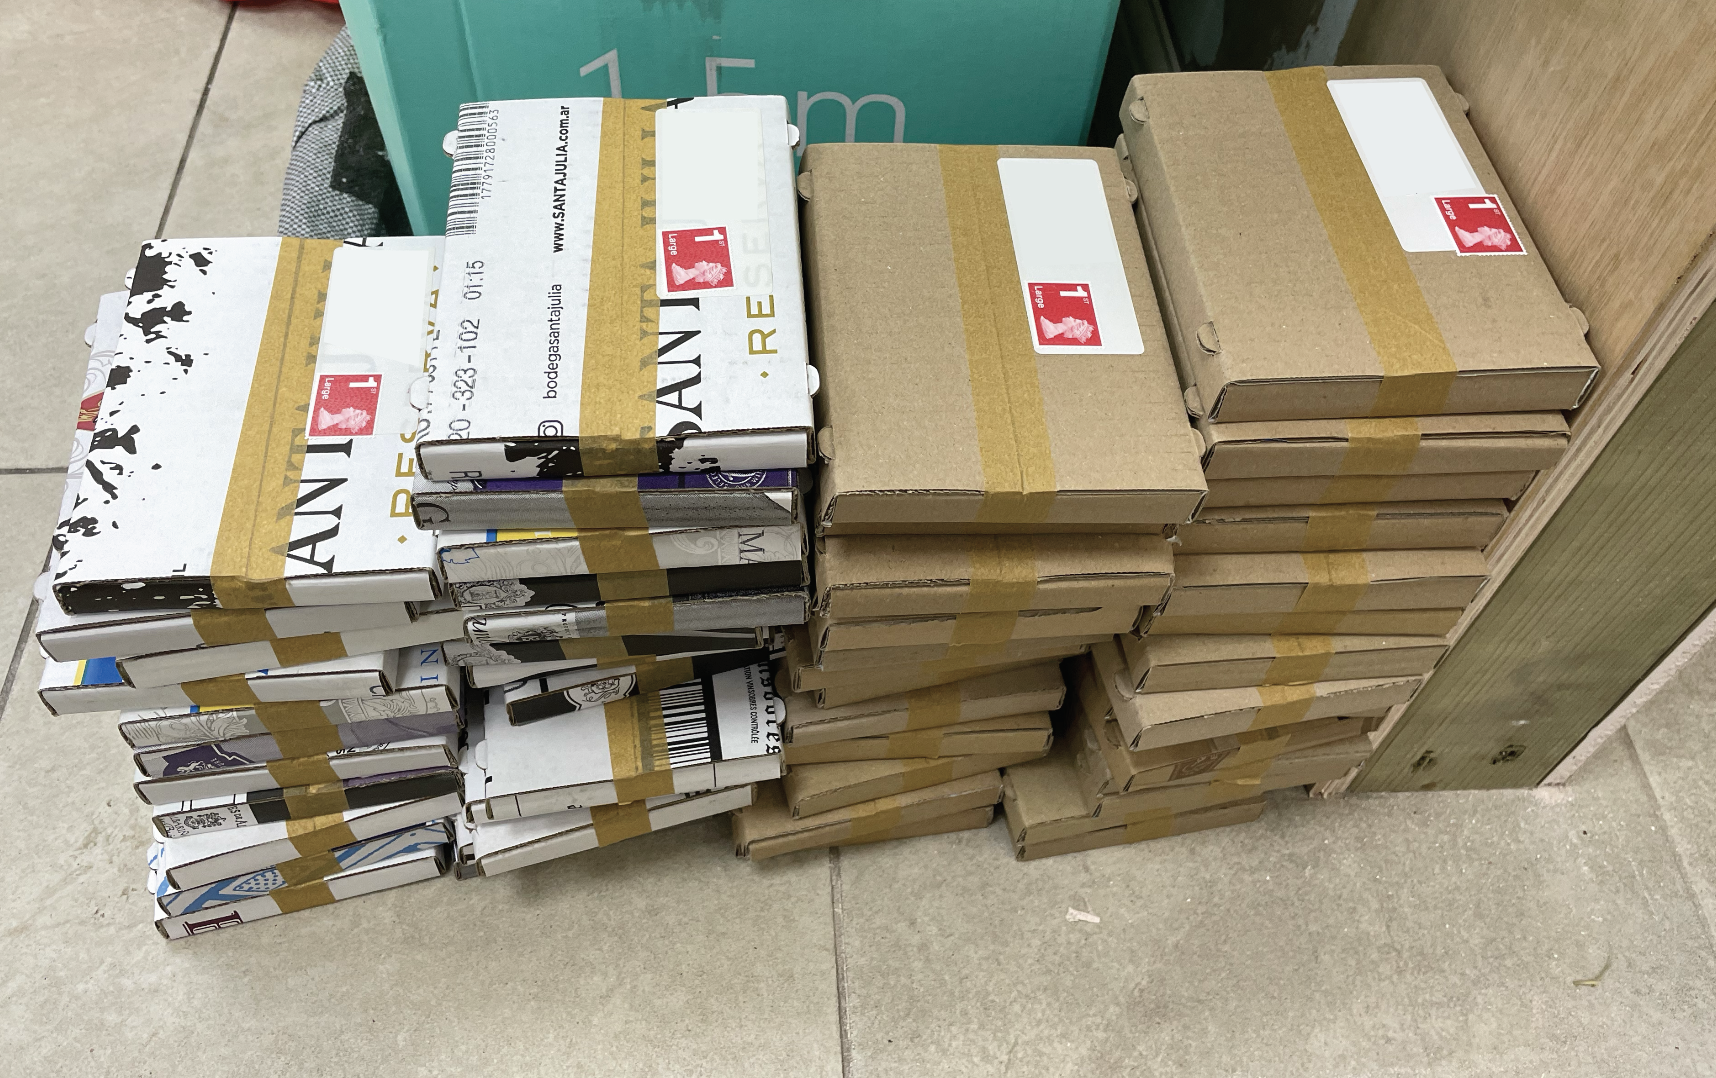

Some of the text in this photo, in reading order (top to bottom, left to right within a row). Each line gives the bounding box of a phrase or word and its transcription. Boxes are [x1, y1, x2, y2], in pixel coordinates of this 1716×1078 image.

[480, 108, 500, 200] 17791728000563
[551, 104, 570, 253] www.SANTAJULIA.com.ar
[1442, 198, 1456, 220] Large
[667, 232, 678, 256] Large
[463, 260, 484, 301] 01:15
[1033, 285, 1046, 309] Large
[541, 284, 563, 400] bodegasantajulia
[322, 376, 335, 400] Large
